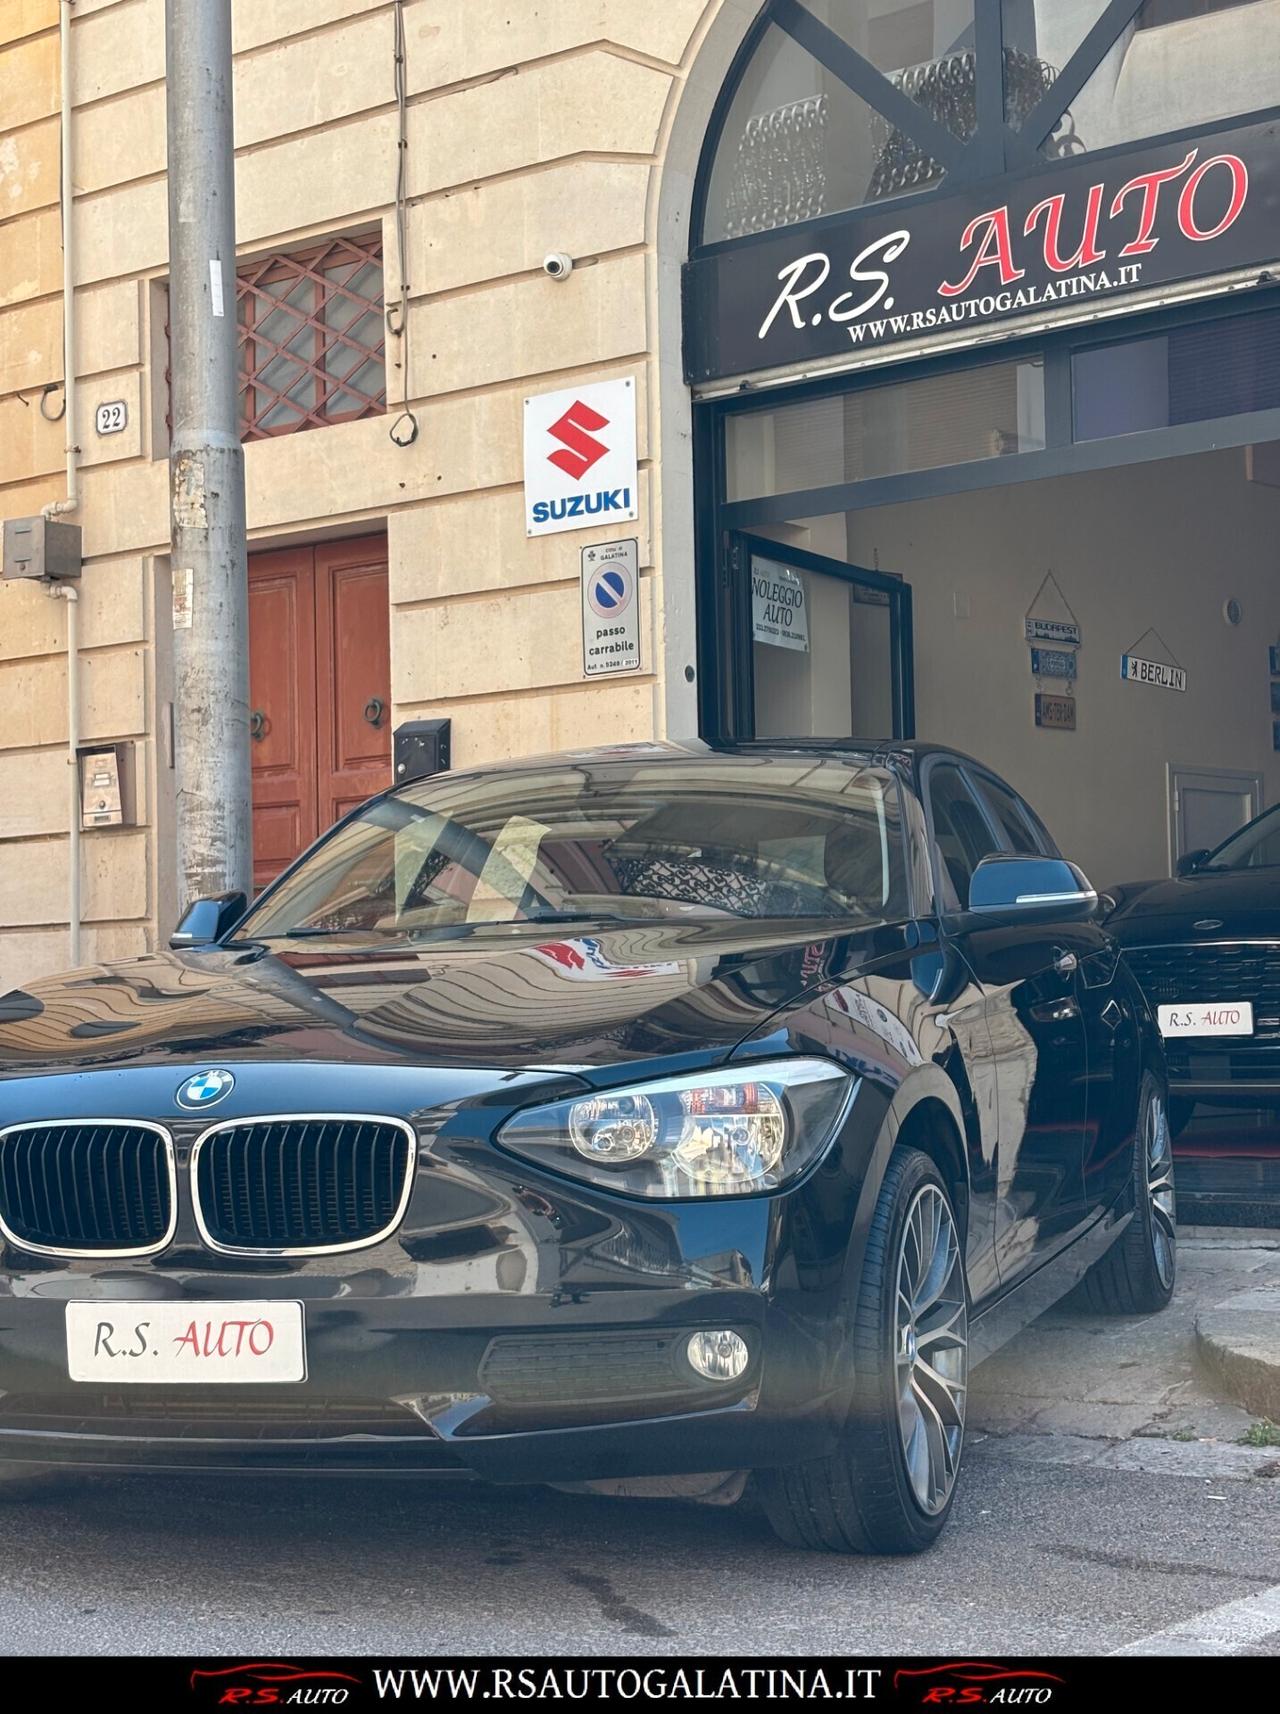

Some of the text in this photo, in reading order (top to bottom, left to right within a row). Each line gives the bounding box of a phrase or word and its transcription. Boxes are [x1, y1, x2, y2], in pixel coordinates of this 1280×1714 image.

[758, 147, 1249, 339] R.S. AUTO
[847, 263, 1142, 344] WWW.RSAUTOGALATINA.IT
[102, 407, 121, 430] 22
[532, 487, 631, 523] SUZUKI
[751, 576, 803, 608] NOLEGGIO
[763, 603, 793, 627] AUTO
[596, 626, 626, 640] passo
[588, 640, 635, 656] carrabile
[1140, 662, 1183, 689] BERLIN
[1168, 1009, 1241, 1027] R.S. AUTO
[94, 1318, 274, 1358] R.S. AUTO
